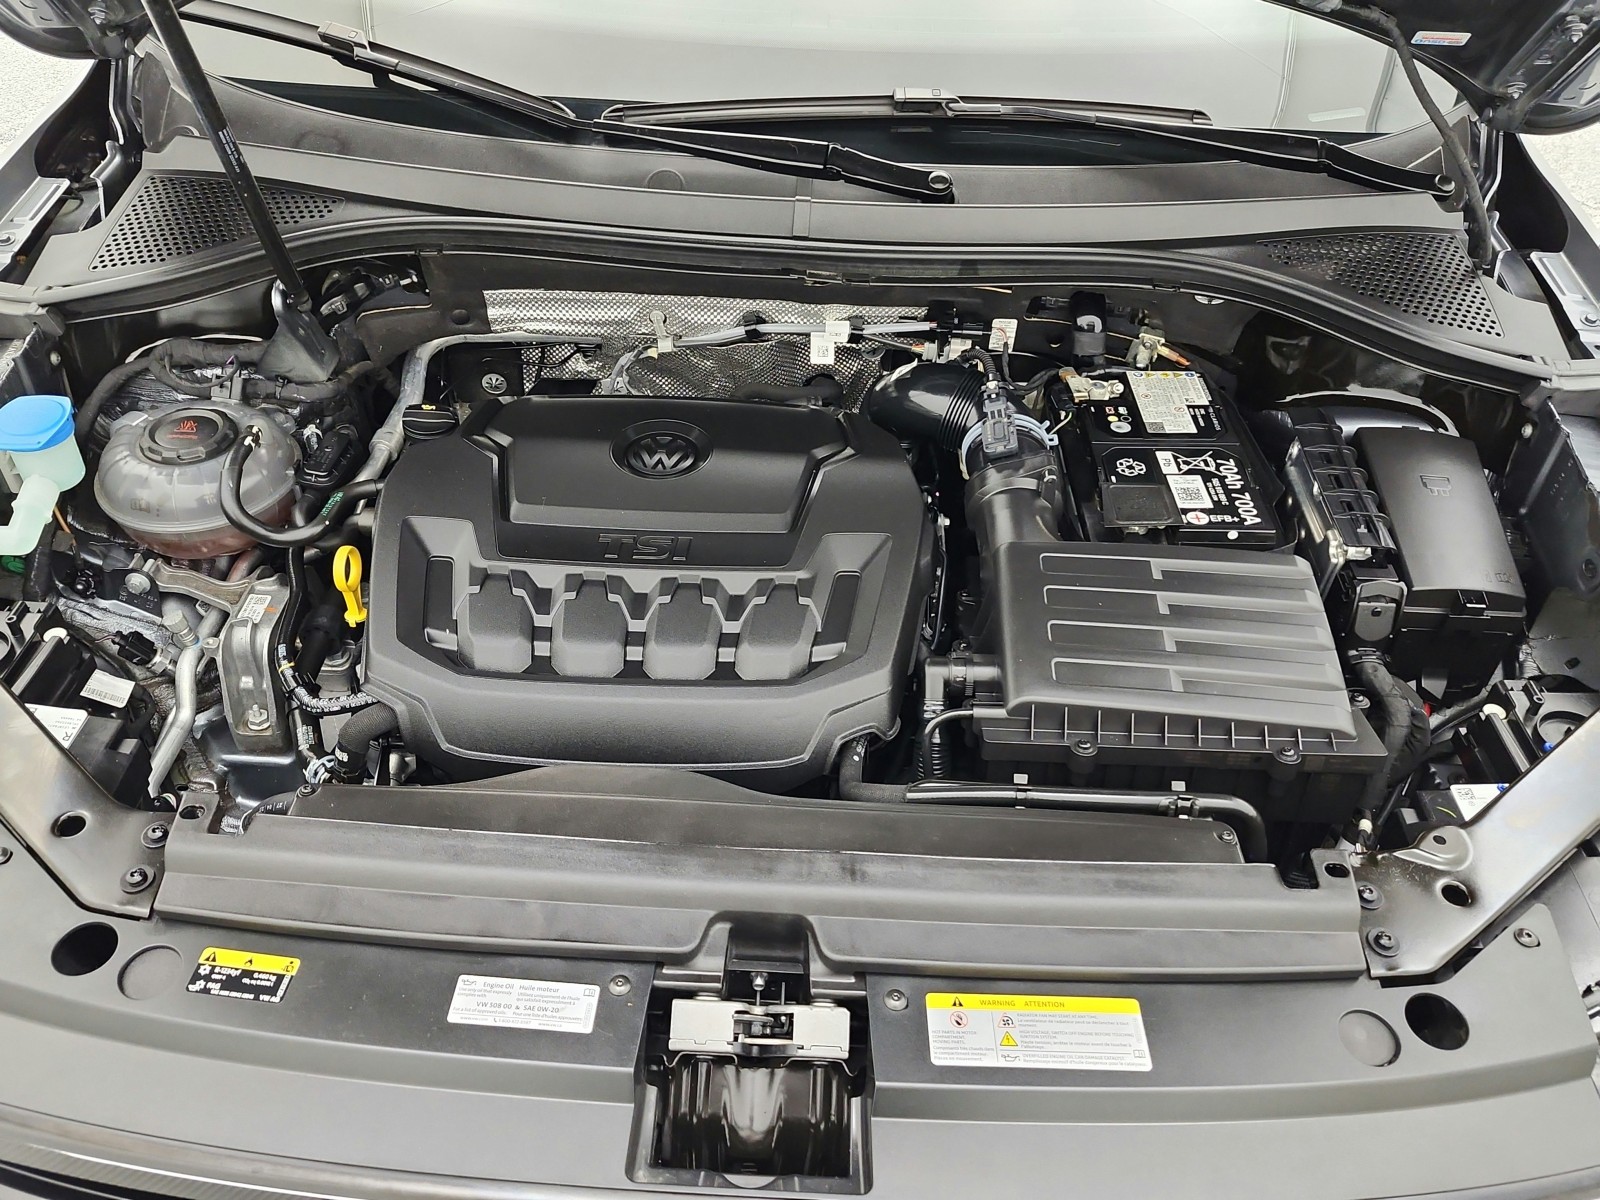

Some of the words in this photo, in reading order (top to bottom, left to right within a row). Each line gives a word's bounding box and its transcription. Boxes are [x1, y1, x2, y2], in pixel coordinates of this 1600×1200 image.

[1161, 458, 1172, 467] Pb
[1216, 458, 1245, 489] 70Ah
[1231, 492, 1262, 526] 700A
[1210, 514, 1240, 523] EFB+
[598, 533, 693, 561] TSI
[206, 982, 221, 990] PAG
[483, 982, 504, 990] Engine
[979, 999, 1016, 1007] WARNING
[537, 1005, 560, 1013] 0W-20
